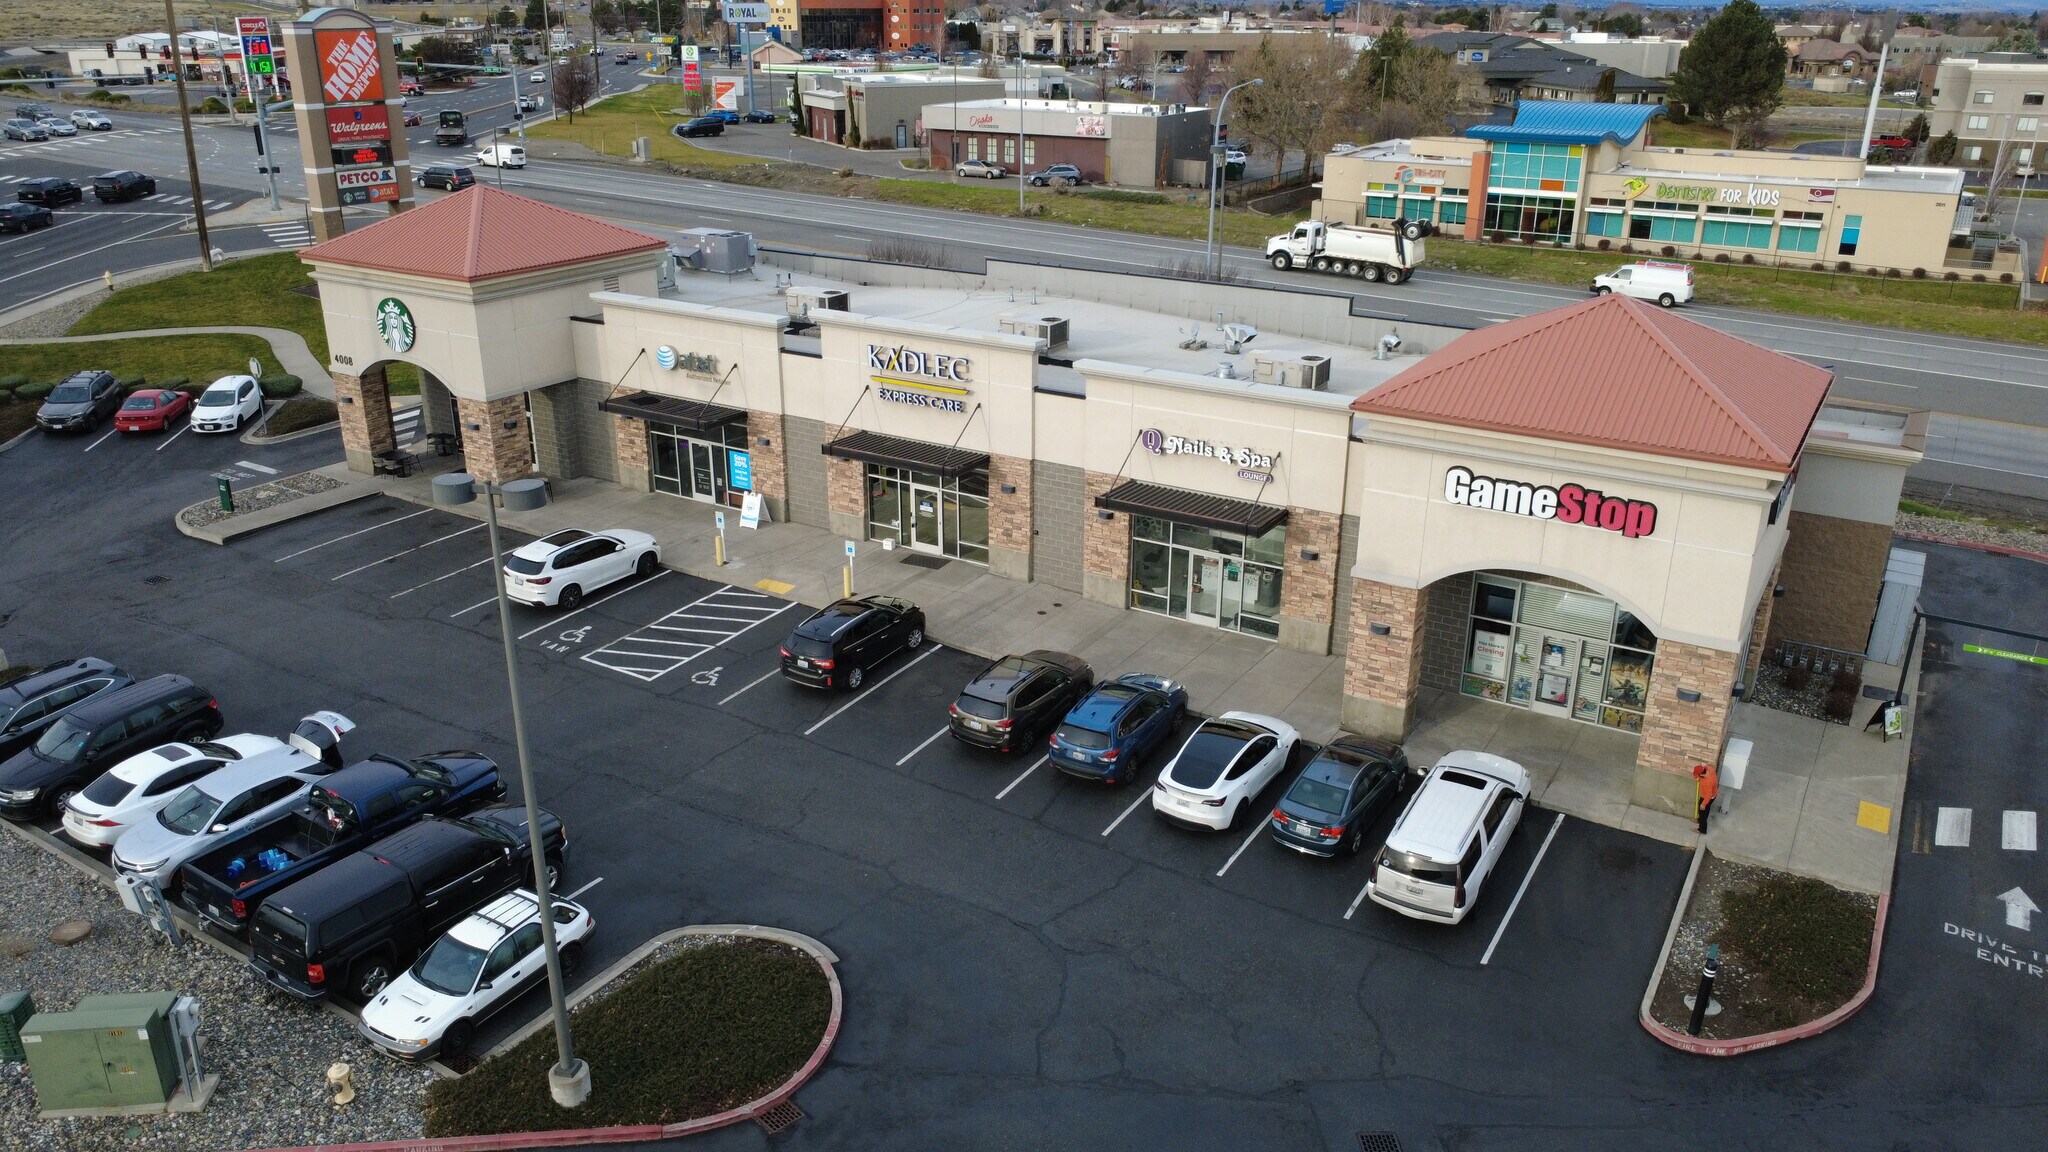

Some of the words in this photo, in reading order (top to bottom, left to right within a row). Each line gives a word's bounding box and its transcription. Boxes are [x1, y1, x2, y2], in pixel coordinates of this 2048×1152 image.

[326, 38, 350, 68] THE
[324, 30, 377, 101] HOME
[348, 55, 380, 101] DEPOT
[330, 121, 388, 135] Walgreens
[969, 113, 993, 126] Osaka
[340, 171, 379, 185] PETCO
[1414, 168, 1446, 178] TRI-CITY
[1719, 188, 1742, 203] FOR
[1747, 183, 1780, 206] KIDS
[334, 354, 354, 367] 4008
[867, 344, 969, 382] KADLEC
[878, 388, 926, 407] EXPRESS
[930, 398, 962, 412] CARE
[1165, 436, 1214, 457] Nails
[1219, 446, 1233, 465] &
[1237, 447, 1273, 468] Spa
[1444, 465, 1658, 538] GameStop
[1477, 646, 1505, 658] Closing
[1996, 651, 2028, 661] CLEARANCE
[1942, 922, 2017, 954] DRIVE
[1977, 947, 2048, 979] ENTR
